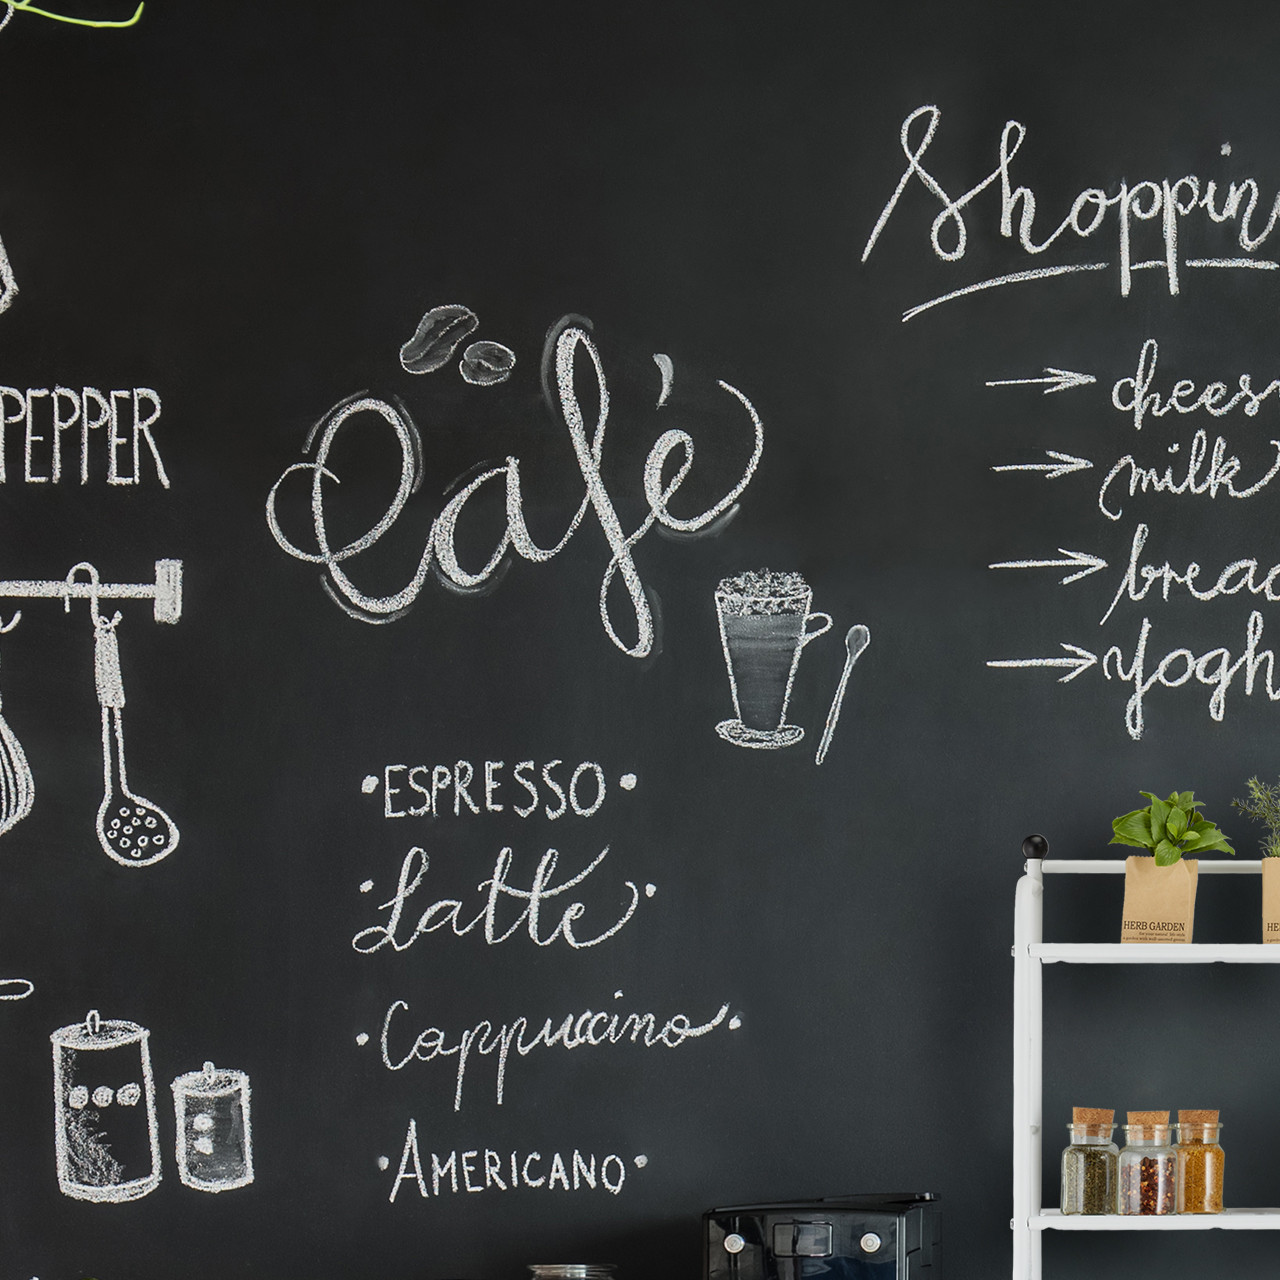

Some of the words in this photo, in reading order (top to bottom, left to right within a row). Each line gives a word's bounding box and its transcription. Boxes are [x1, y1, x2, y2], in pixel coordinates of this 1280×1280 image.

[0, 385, 171, 490] PEPPER
[384, 759, 607, 821] ESPRESSO
[351, 846, 639, 954] Latte
[1123, 920, 1148, 930] HERB
[1149, 921, 1185, 931] GARDEN
[380, 989, 731, 1113] Cappuccino
